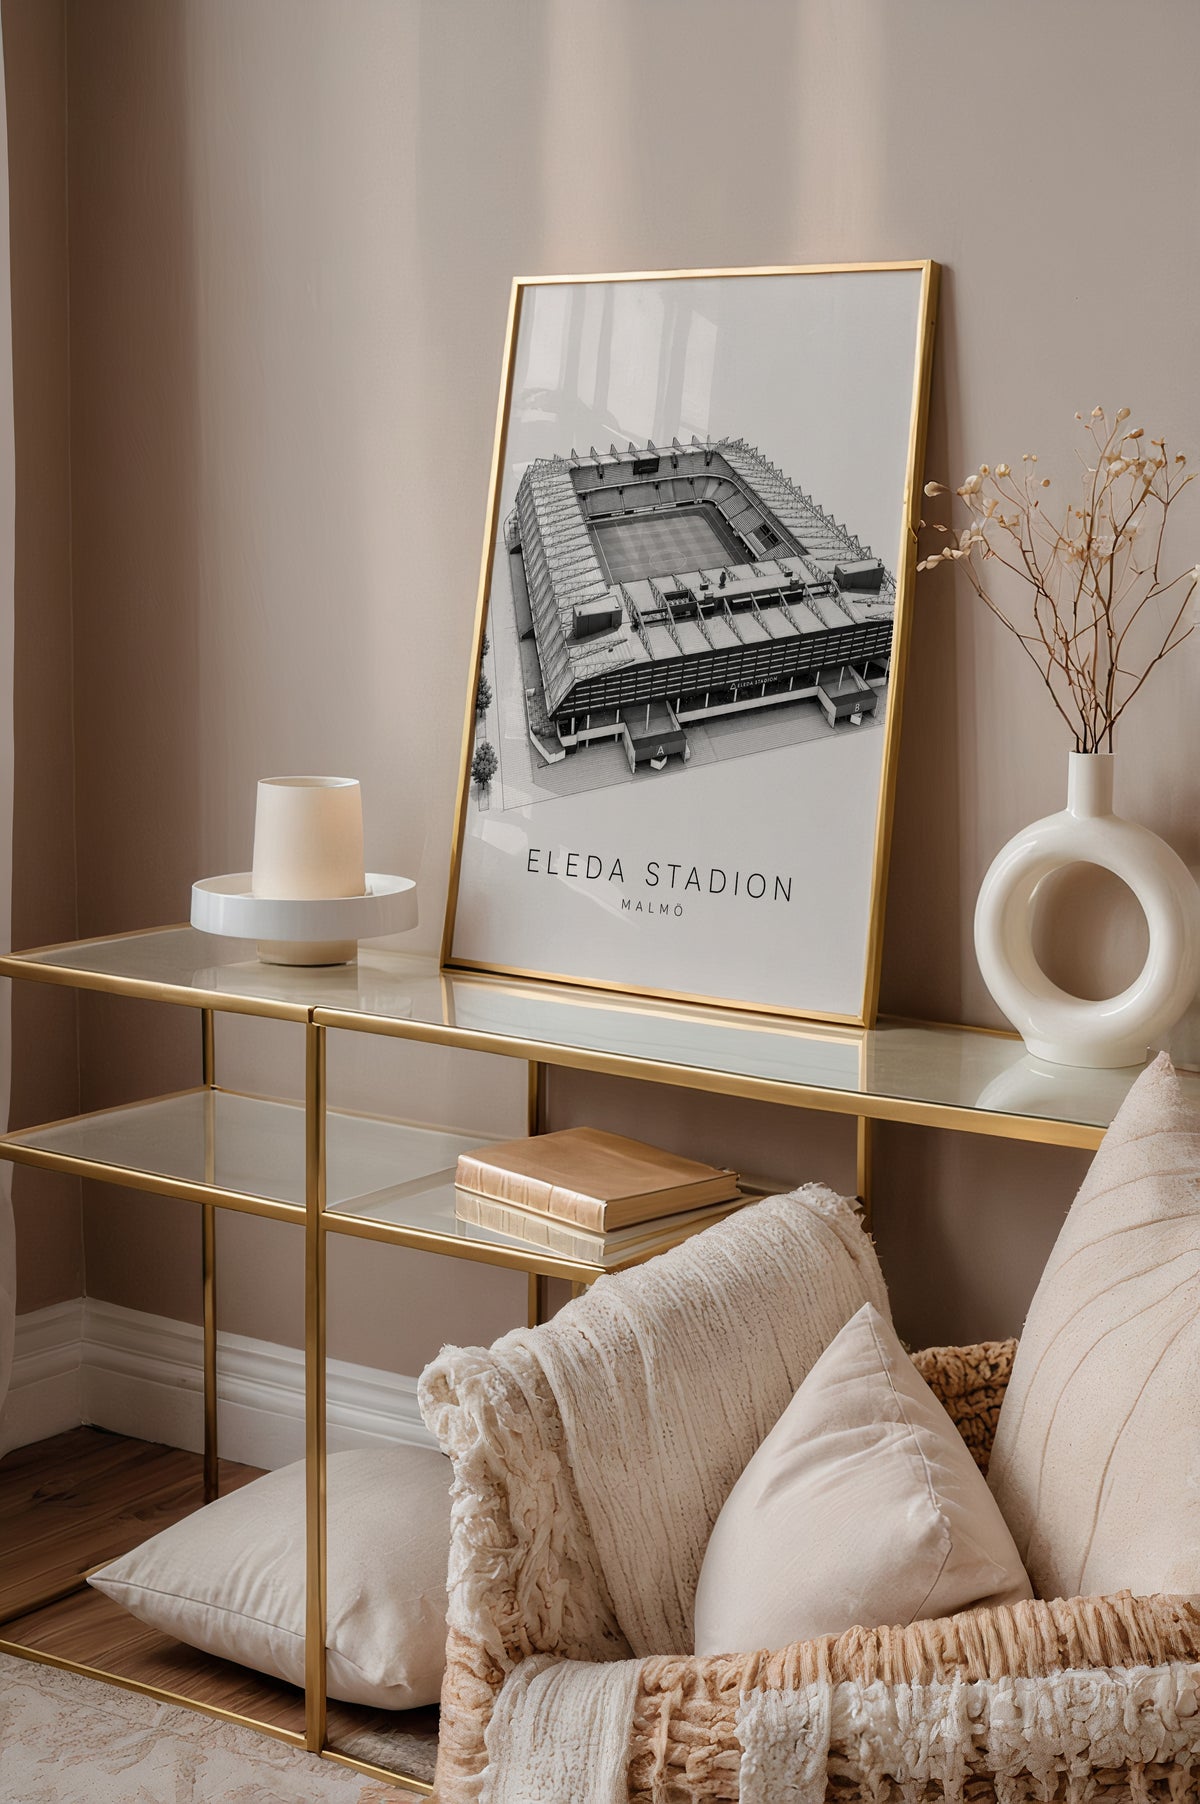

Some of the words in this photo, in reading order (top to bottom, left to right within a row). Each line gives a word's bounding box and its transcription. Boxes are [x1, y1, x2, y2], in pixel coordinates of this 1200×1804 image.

[854, 703, 860, 712] B
[656, 745, 665, 756] A
[527, 848, 625, 883] ELEDA
[645, 861, 792, 902] STADION
[621, 898, 683, 917] MALMÖ
